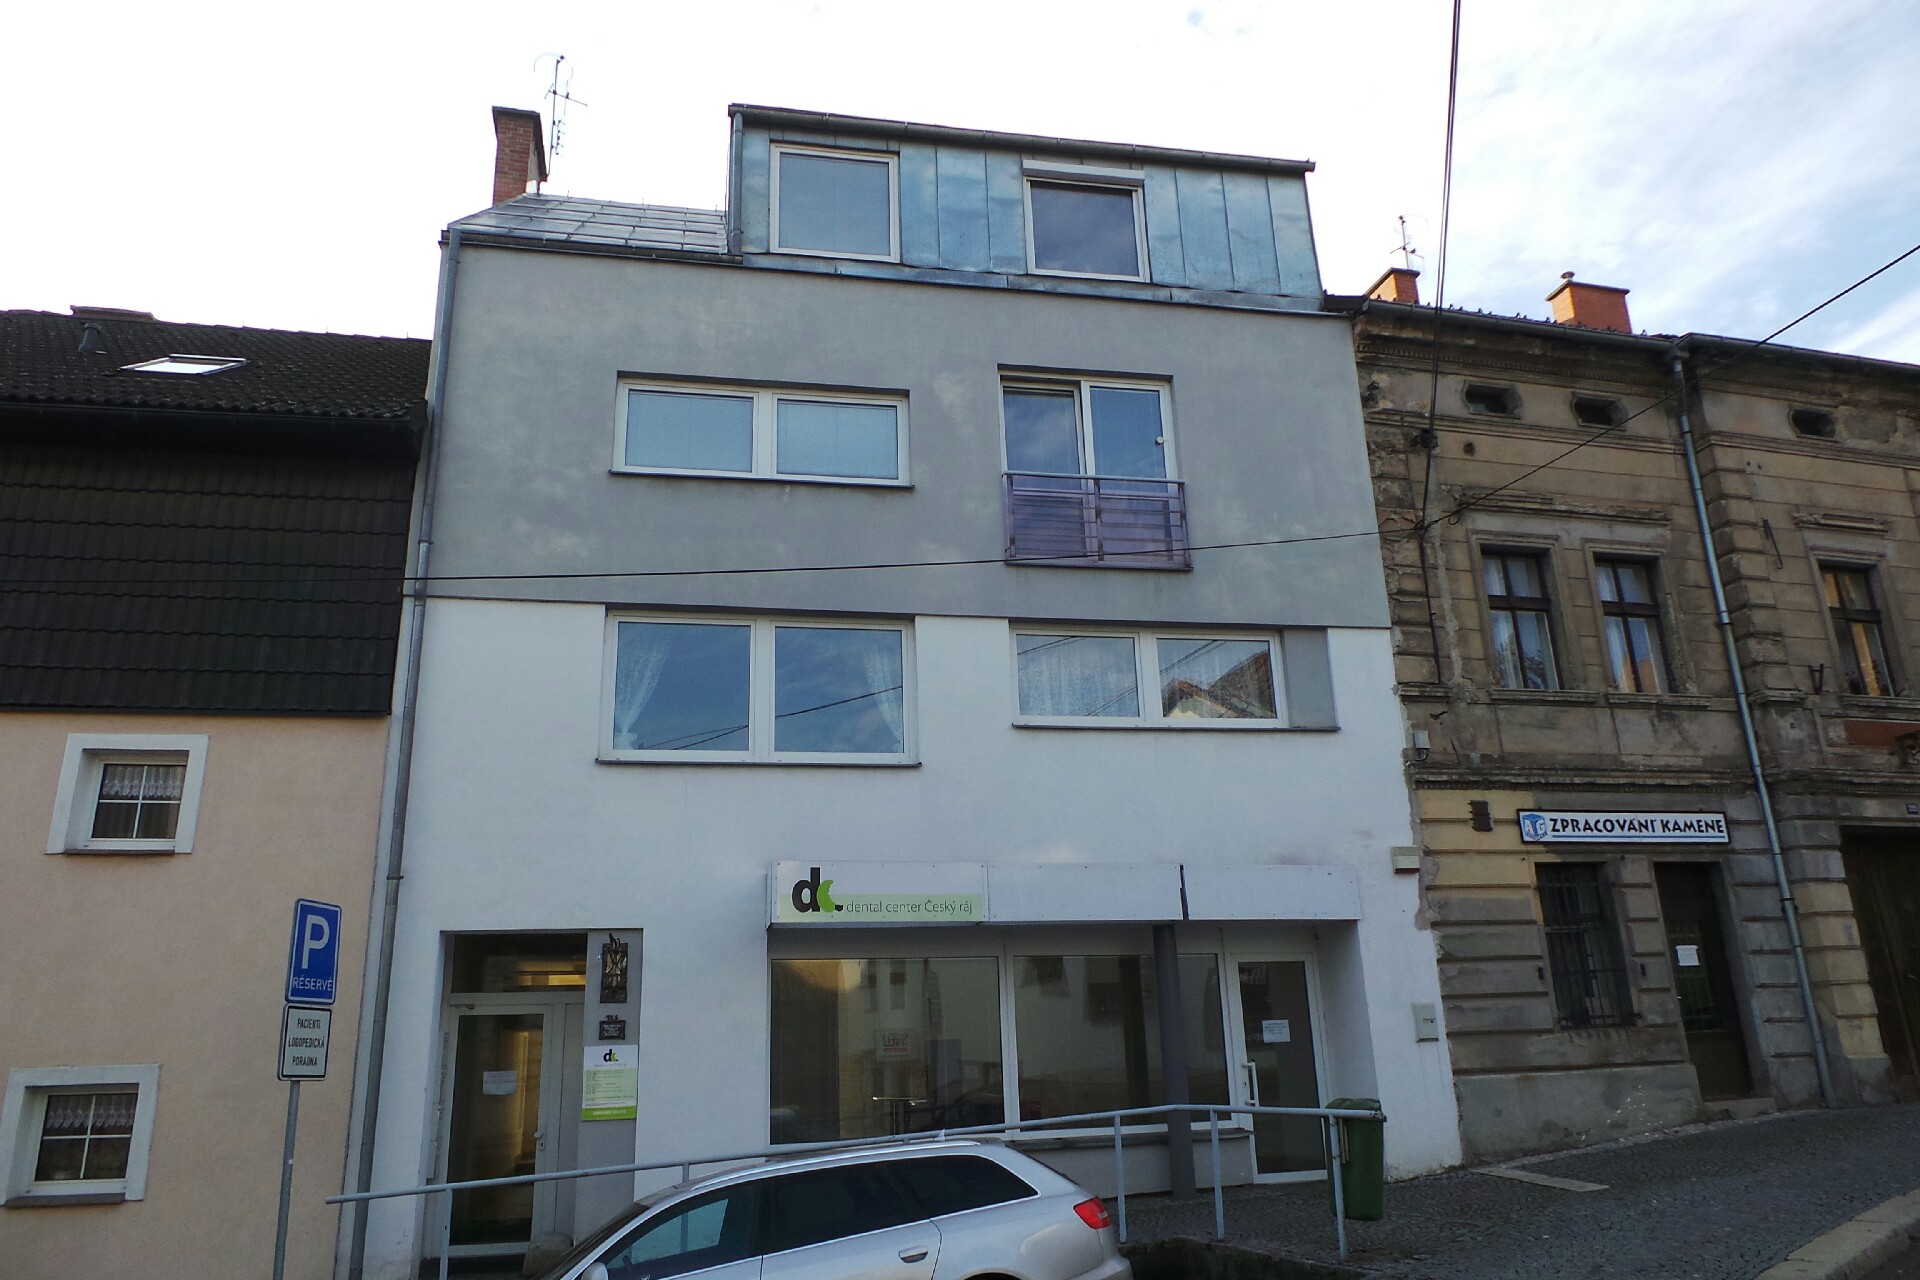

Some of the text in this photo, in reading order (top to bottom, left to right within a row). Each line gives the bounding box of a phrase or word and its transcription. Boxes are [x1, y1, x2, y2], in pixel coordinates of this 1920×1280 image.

[1549, 817, 1724, 833] ZPRACOVÁNÍ KAMENE
[847, 899, 973, 915] dental center Český ráj
[301, 914, 330, 969] P
[292, 974, 333, 991] RÉSERVÉ
[297, 1018, 321, 1030] PACIENTI
[288, 1036, 325, 1048] LOGOPEDICKÁ
[292, 1056, 318, 1067] PORADNA
